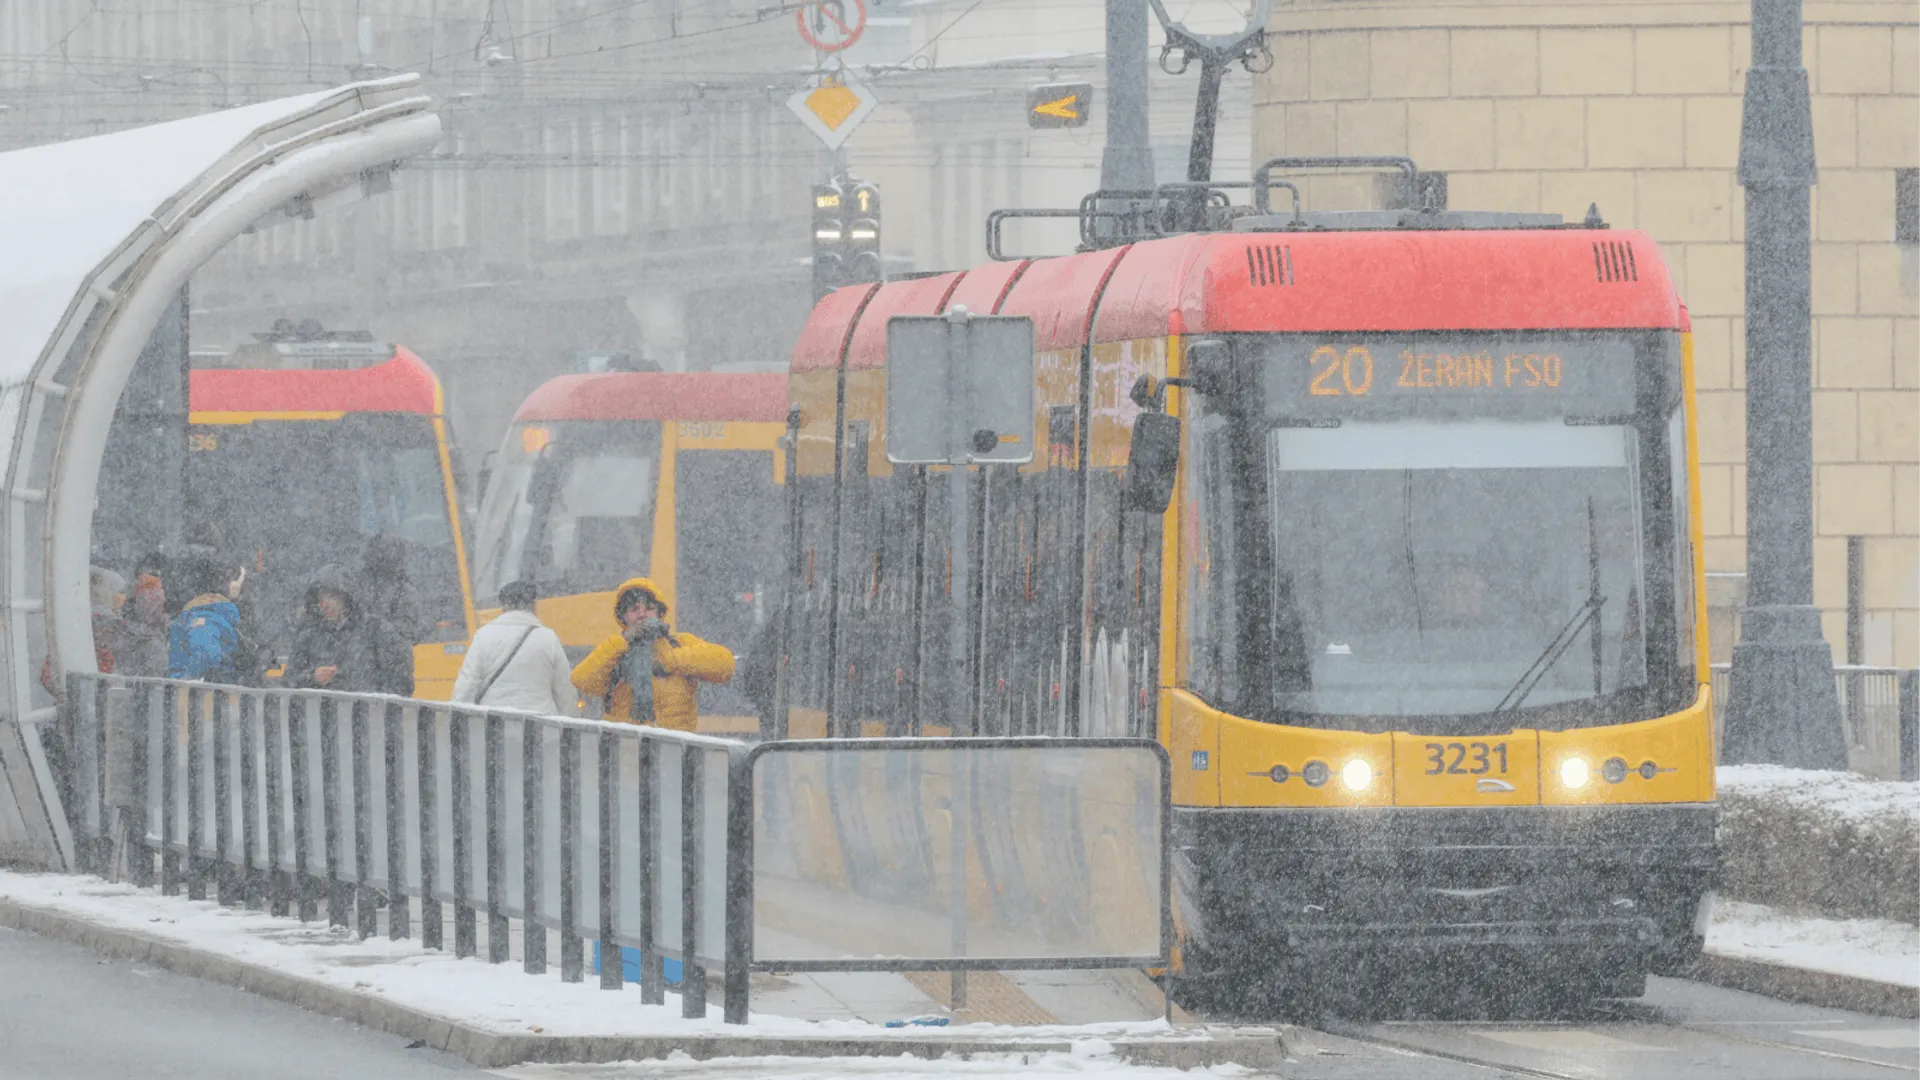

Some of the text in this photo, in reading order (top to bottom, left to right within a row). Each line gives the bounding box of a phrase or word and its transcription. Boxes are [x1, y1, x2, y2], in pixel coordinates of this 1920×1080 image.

[1309, 346, 1561, 395] 20 ŻERAŃ FSO
[678, 421, 725, 439] 3502
[1425, 742, 1507, 775] 3231
